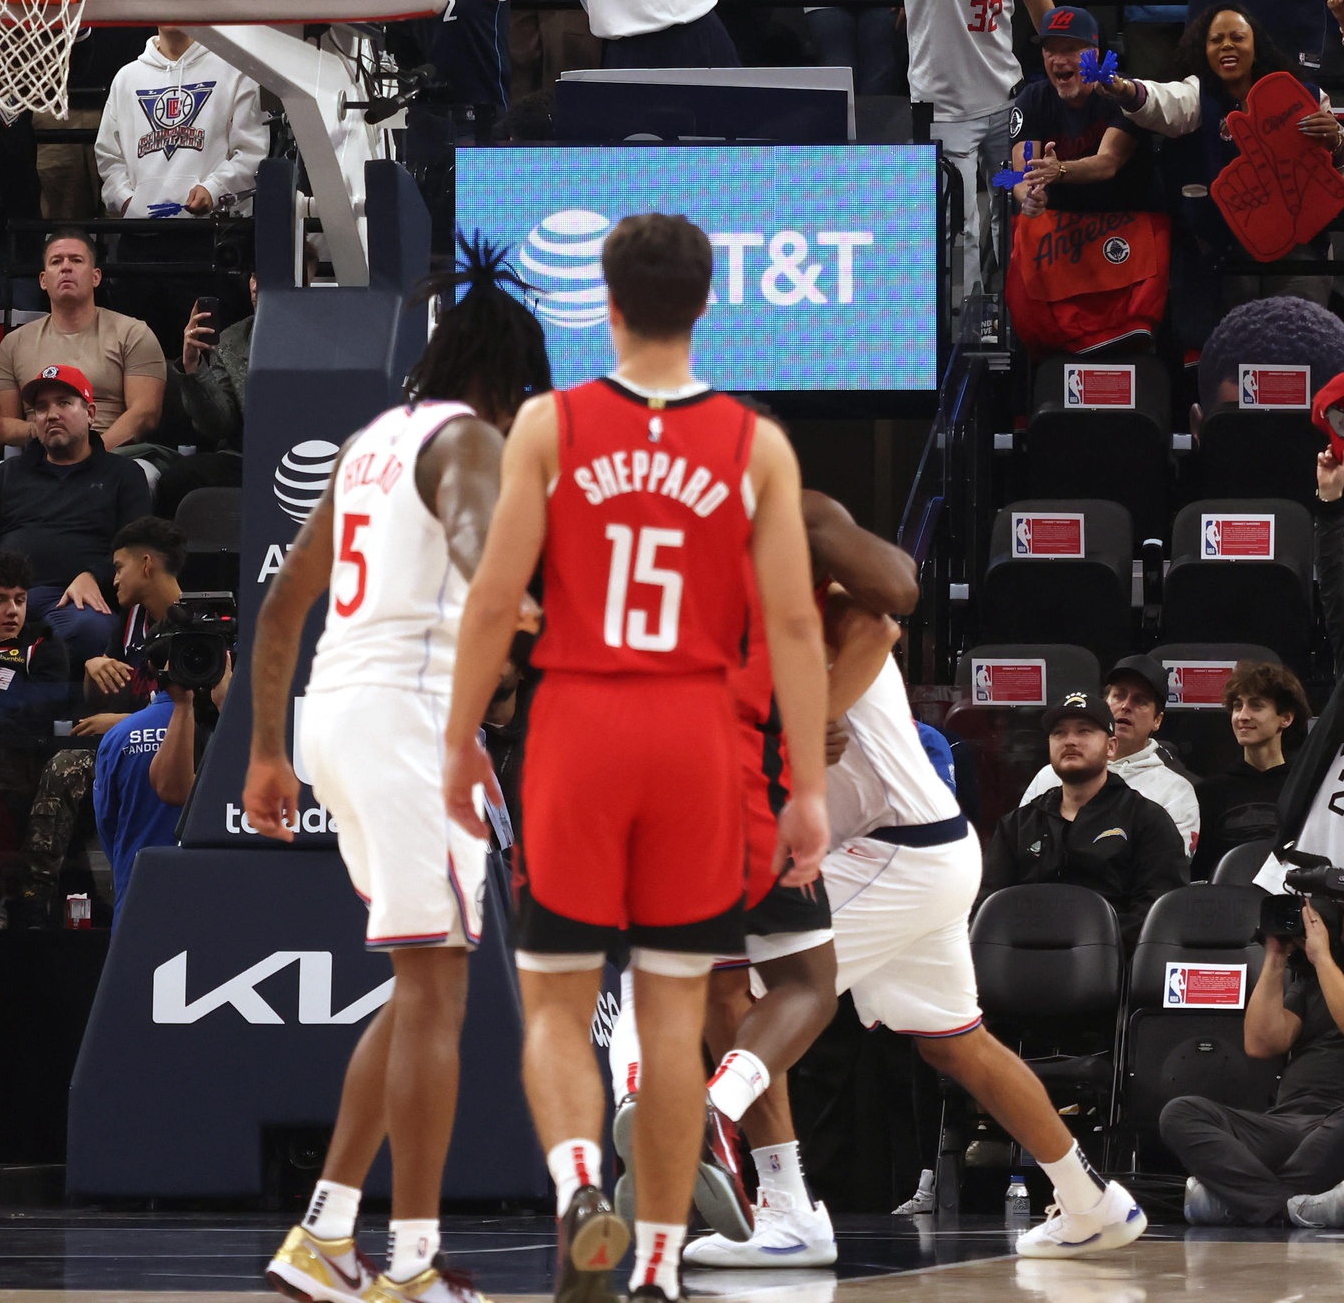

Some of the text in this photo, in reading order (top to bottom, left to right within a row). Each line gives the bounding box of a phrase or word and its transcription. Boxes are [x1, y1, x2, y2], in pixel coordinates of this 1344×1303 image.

[1048, 10, 1074, 30] LA
[573, 449, 730, 519] SHEPPARD
[335, 513, 371, 618] 5
[604, 523, 685, 653] 15
